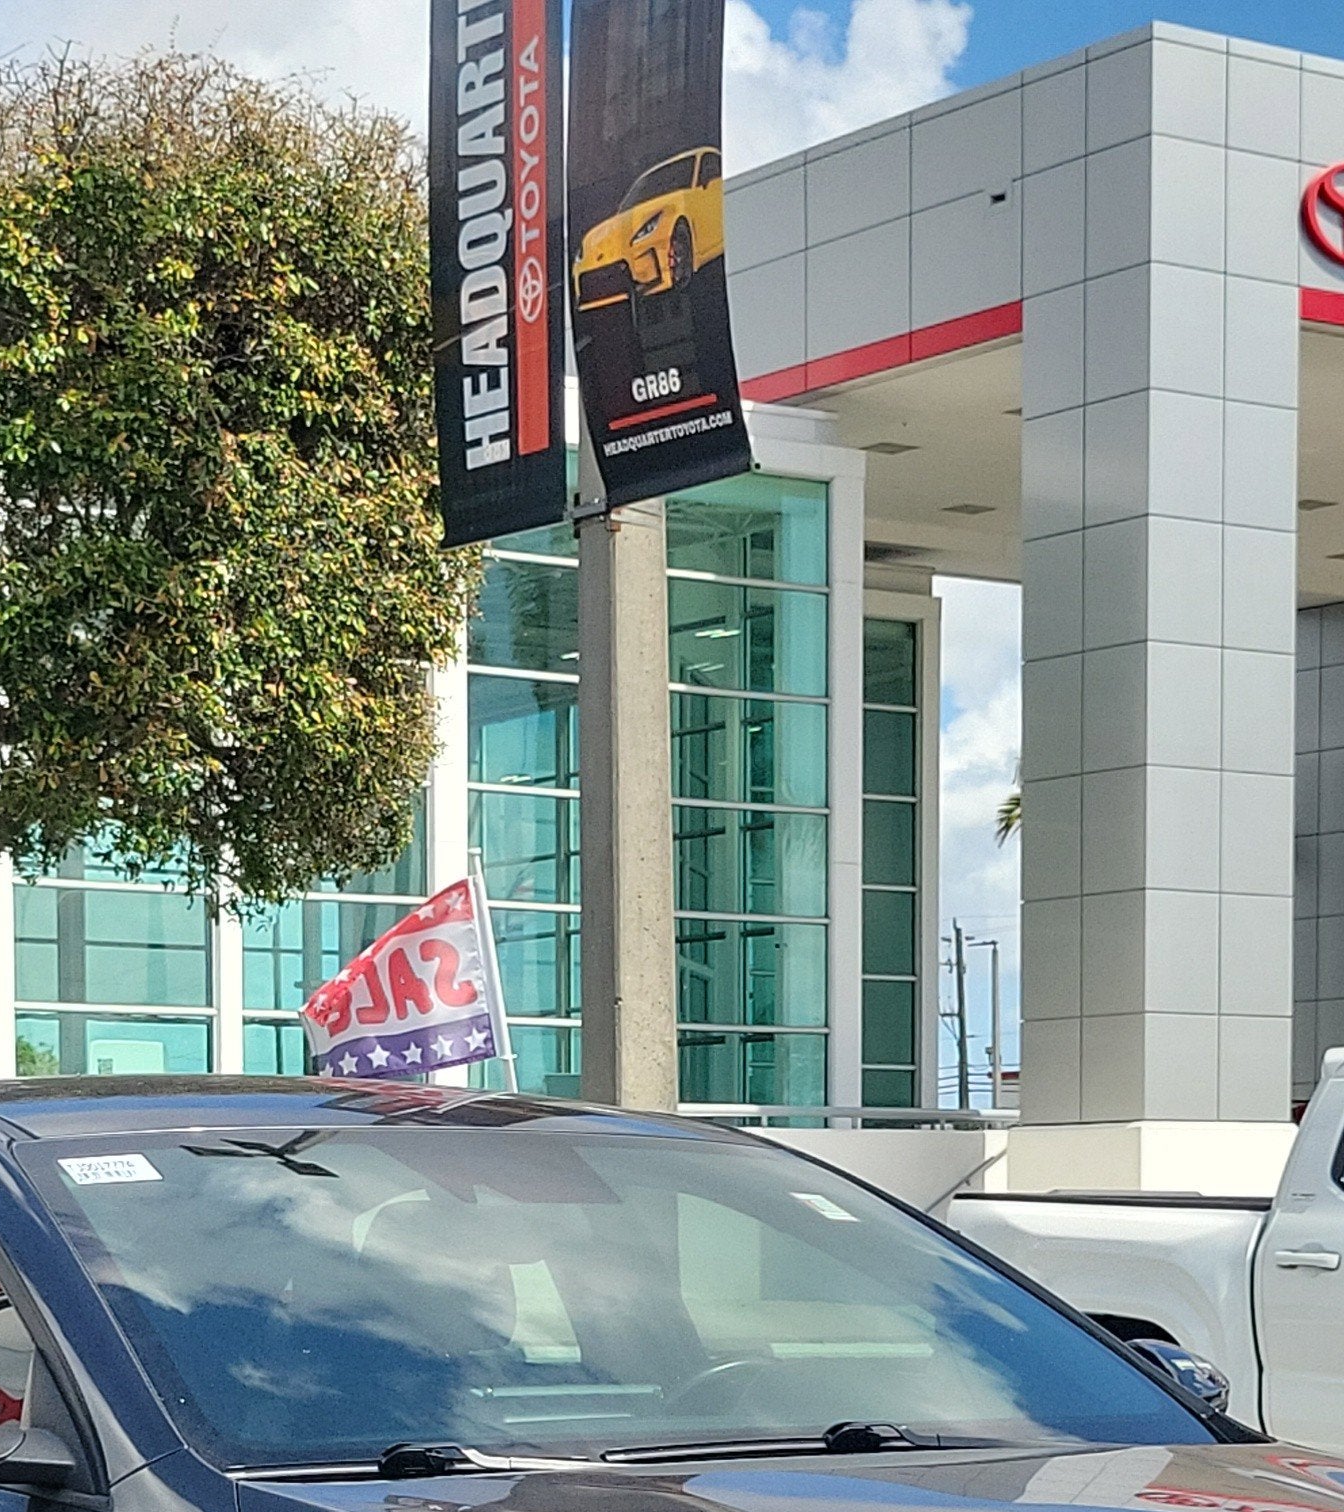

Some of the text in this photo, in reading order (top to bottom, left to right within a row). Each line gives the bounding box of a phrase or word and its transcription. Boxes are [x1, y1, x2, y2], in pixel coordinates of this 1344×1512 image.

[518, 35, 541, 249] TOYOTA
[458, 0, 514, 470] HEADQUART
[602, 410, 733, 457] HEADQUARTERTOYOTA.COM
[631, 367, 681, 402] GR86
